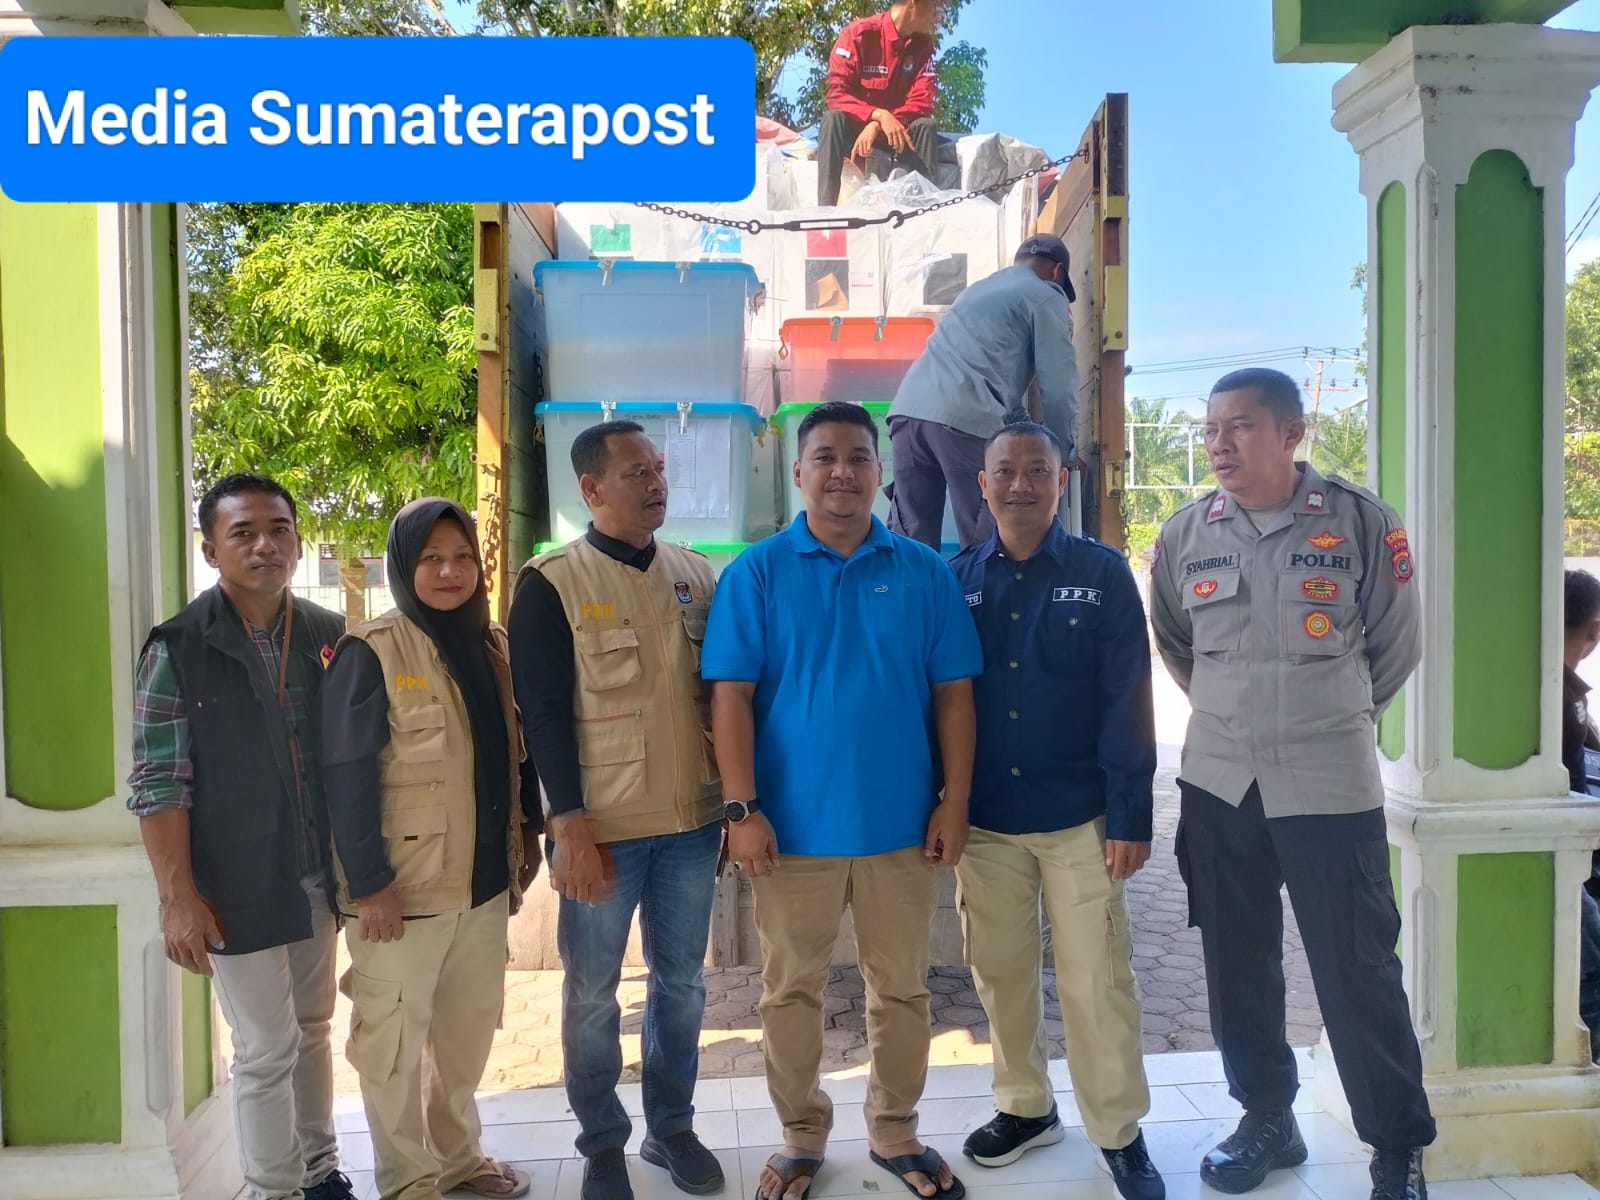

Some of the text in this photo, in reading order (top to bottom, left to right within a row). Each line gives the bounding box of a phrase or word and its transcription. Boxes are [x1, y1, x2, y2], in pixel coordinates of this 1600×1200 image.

[1186, 555, 1234, 576] SYAHRIAL
[1290, 553, 1352, 570] POLRI
[1060, 589, 1097, 601] PPK
[395, 675, 429, 689] PPK
